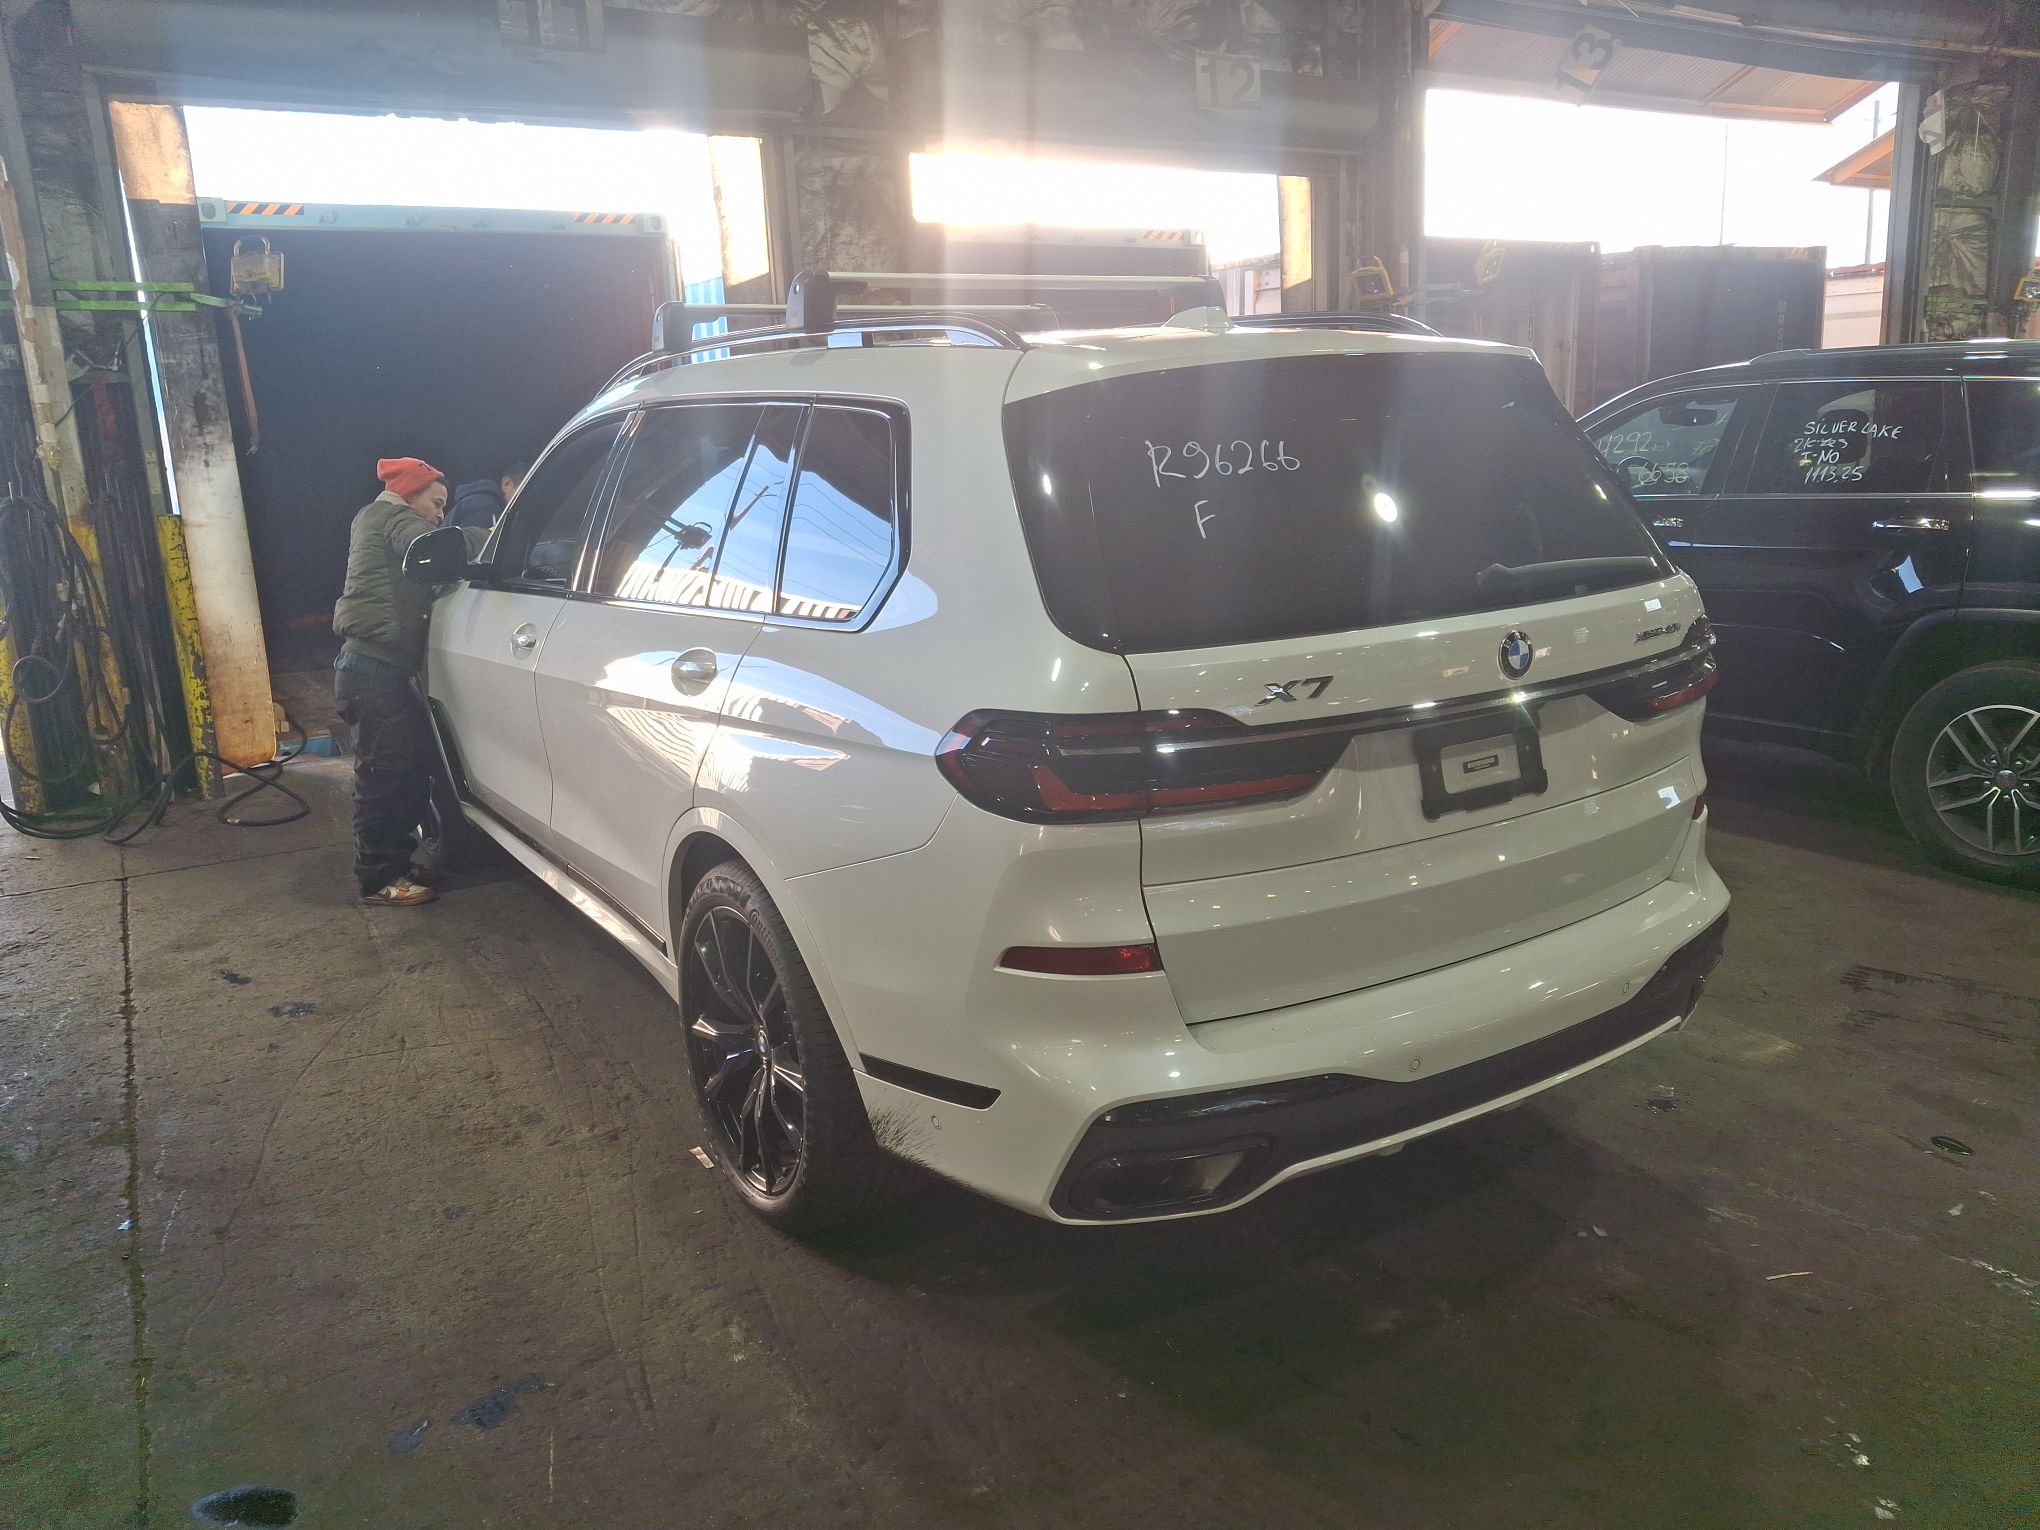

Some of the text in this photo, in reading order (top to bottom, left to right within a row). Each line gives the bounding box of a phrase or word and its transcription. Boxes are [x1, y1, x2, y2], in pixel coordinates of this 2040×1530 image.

[1199, 57, 1258, 108] 12
[1556, 32, 1614, 95] 13
[1861, 422, 1904, 440] LAKE
[1193, 499, 1217, 540] F
[1254, 675, 1335, 707] X7
